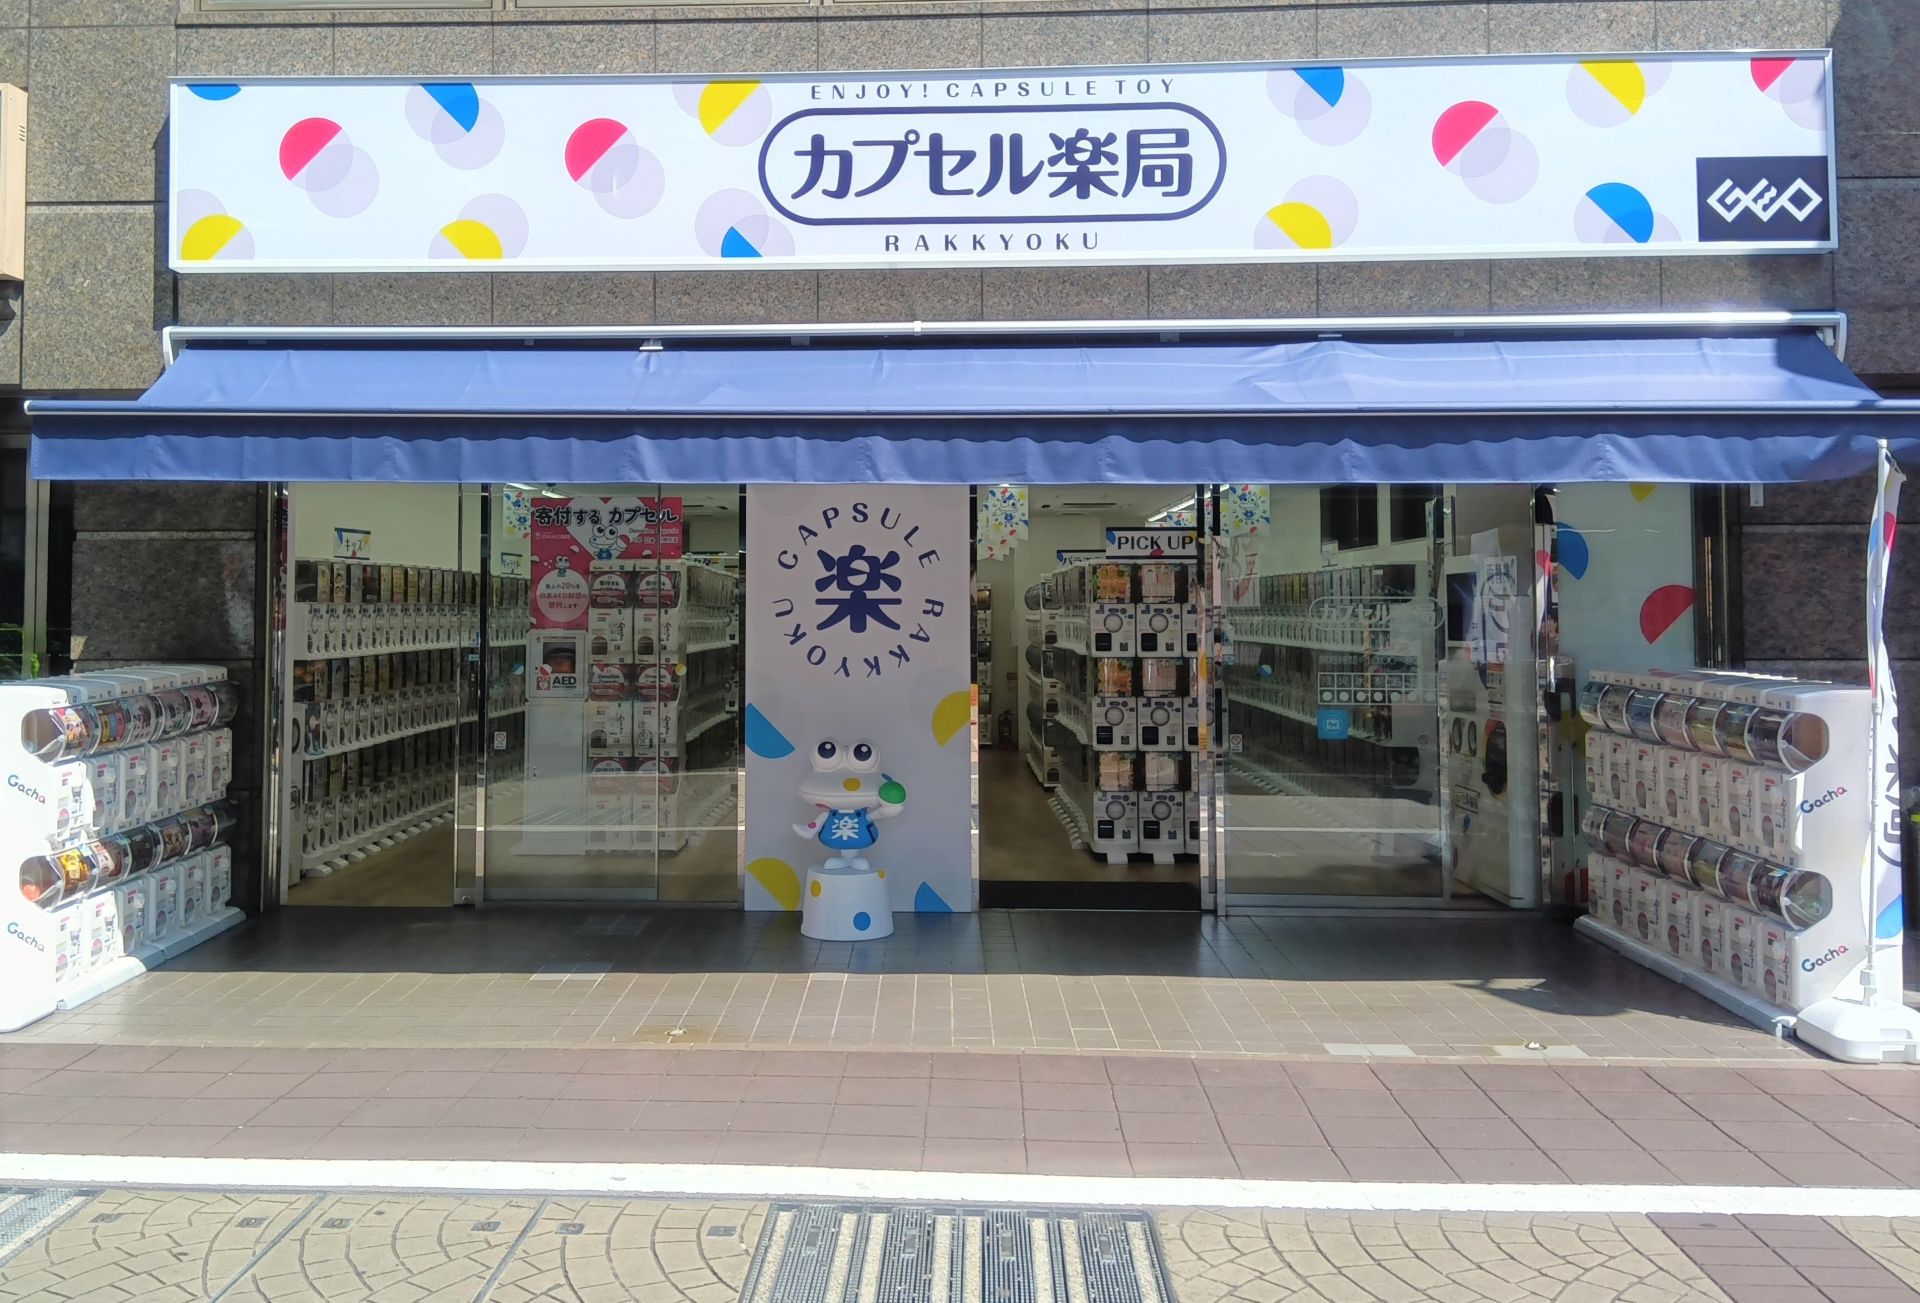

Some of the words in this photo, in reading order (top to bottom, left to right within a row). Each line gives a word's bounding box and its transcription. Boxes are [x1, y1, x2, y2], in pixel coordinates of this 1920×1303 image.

[811, 83, 928, 100] ENJOY!
[946, 80, 1098, 98] CAPSULE
[1115, 78, 1175, 95] TOY
[790, 127, 1194, 201] カプセル楽局
[1706, 177, 1823, 223] GEO
[884, 231, 1100, 252] RAKKYOKU
[535, 506, 600, 526] 寄付する
[608, 506, 679, 526] カプセル
[777, 502, 941, 570] CAPSULE
[1117, 535, 1161, 551] PICK
[1167, 535, 1194, 550] UP
[814, 544, 902, 634] 楽
[772, 598, 945, 679] RAKKYOKU
[552, 675, 577, 686] AED
[7, 774, 46, 805] Gacha
[1800, 784, 1848, 814] Gacha
[831, 816, 860, 841] 楽
[7, 922, 45, 953] Gacha
[1801, 944, 1849, 973] Gacha
